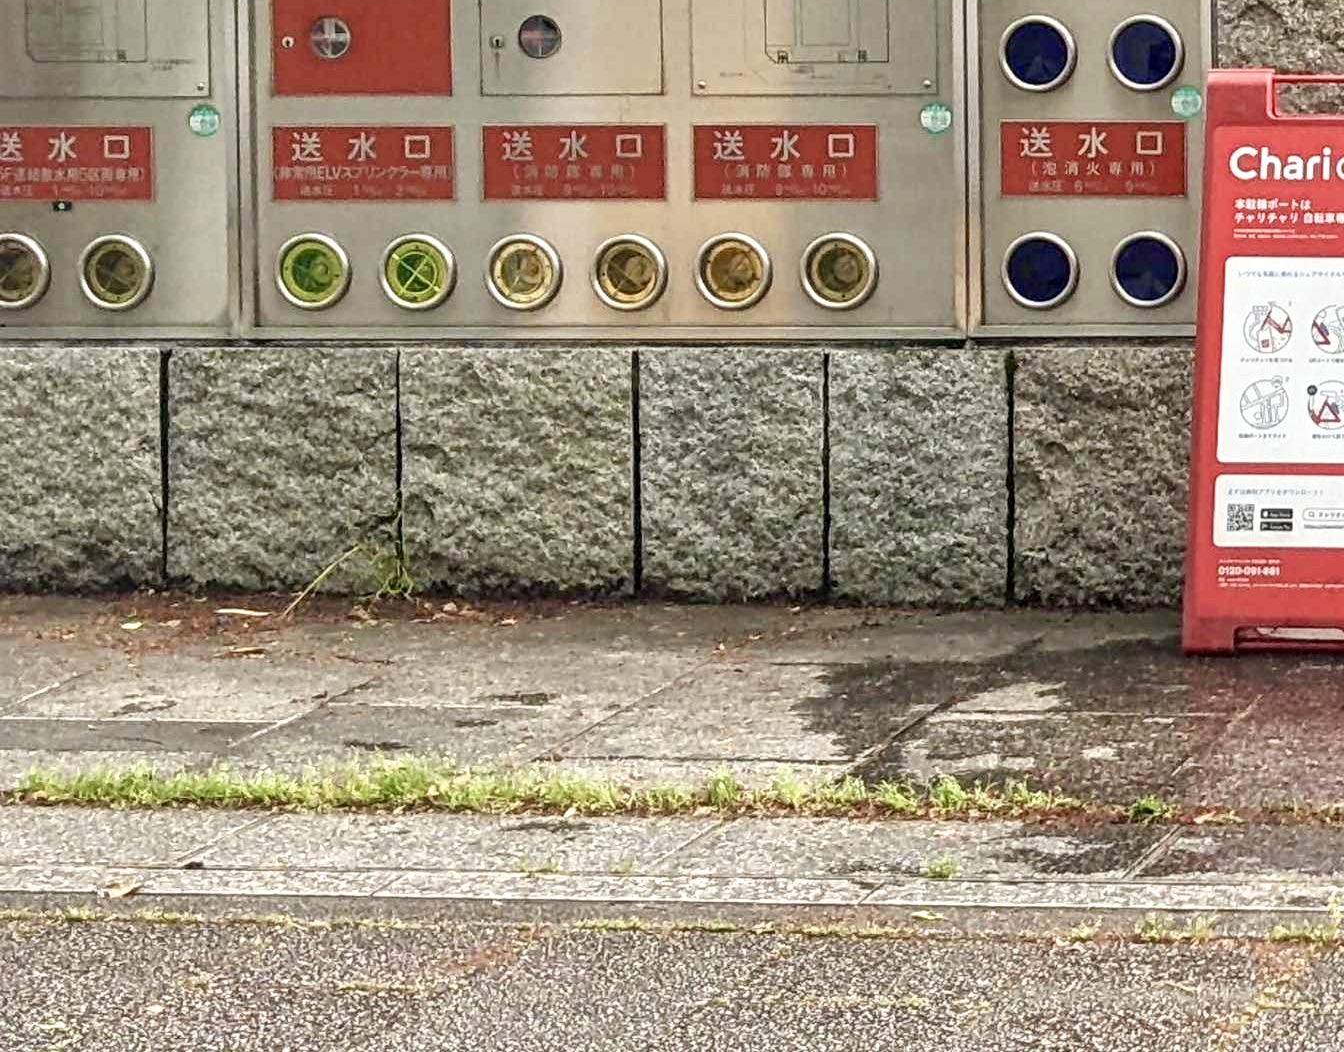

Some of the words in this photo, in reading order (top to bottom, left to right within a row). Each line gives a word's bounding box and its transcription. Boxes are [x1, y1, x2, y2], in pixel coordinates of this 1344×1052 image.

[0, 132, 130, 162] 送水口
[292, 132, 431, 162] 送水口
[502, 130, 642, 161] 送水口
[713, 130, 854, 161] 送水口
[1020, 127, 1163, 158] 送水口
[1234, 213, 1298, 224] チャリチャリ
[1235, 199, 1311, 210] 本駐輪ポートは
